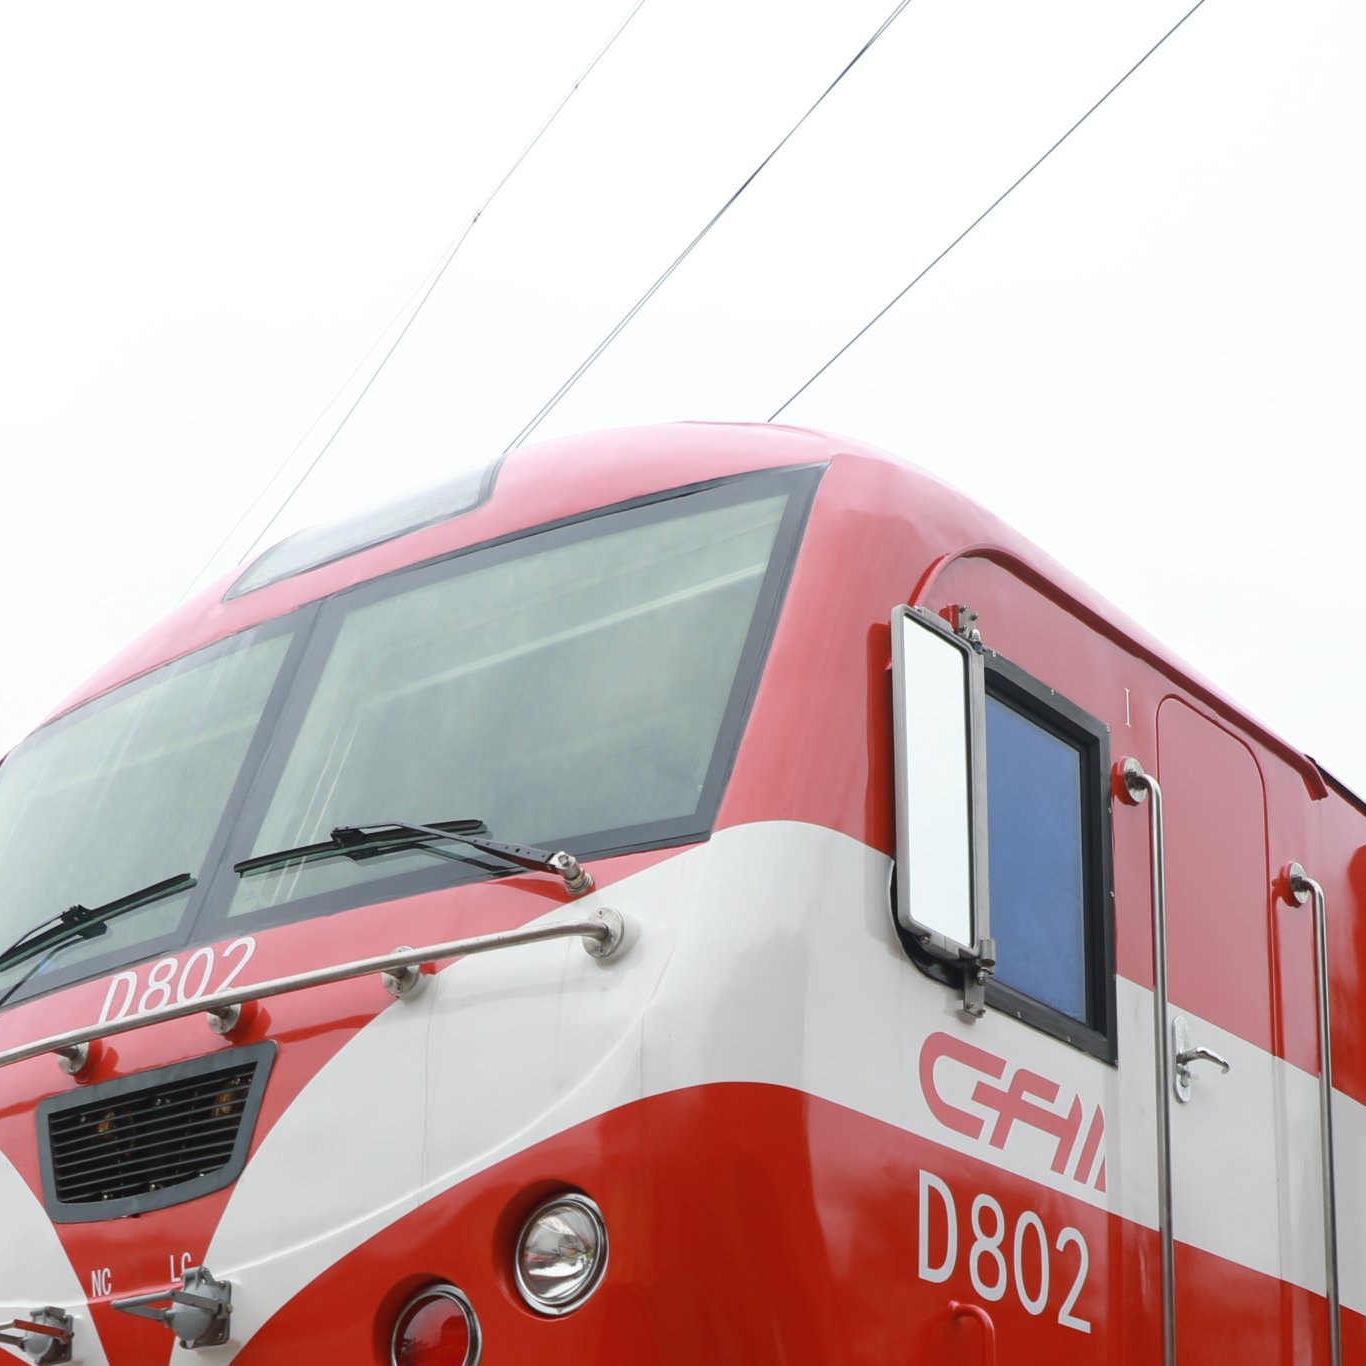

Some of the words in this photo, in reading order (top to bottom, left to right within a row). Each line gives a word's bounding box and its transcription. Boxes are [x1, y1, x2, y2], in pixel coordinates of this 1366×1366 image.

[98, 936, 256, 1026] D802
[91, 1267, 112, 1298] NC
[918, 1168, 1092, 1334] D802
